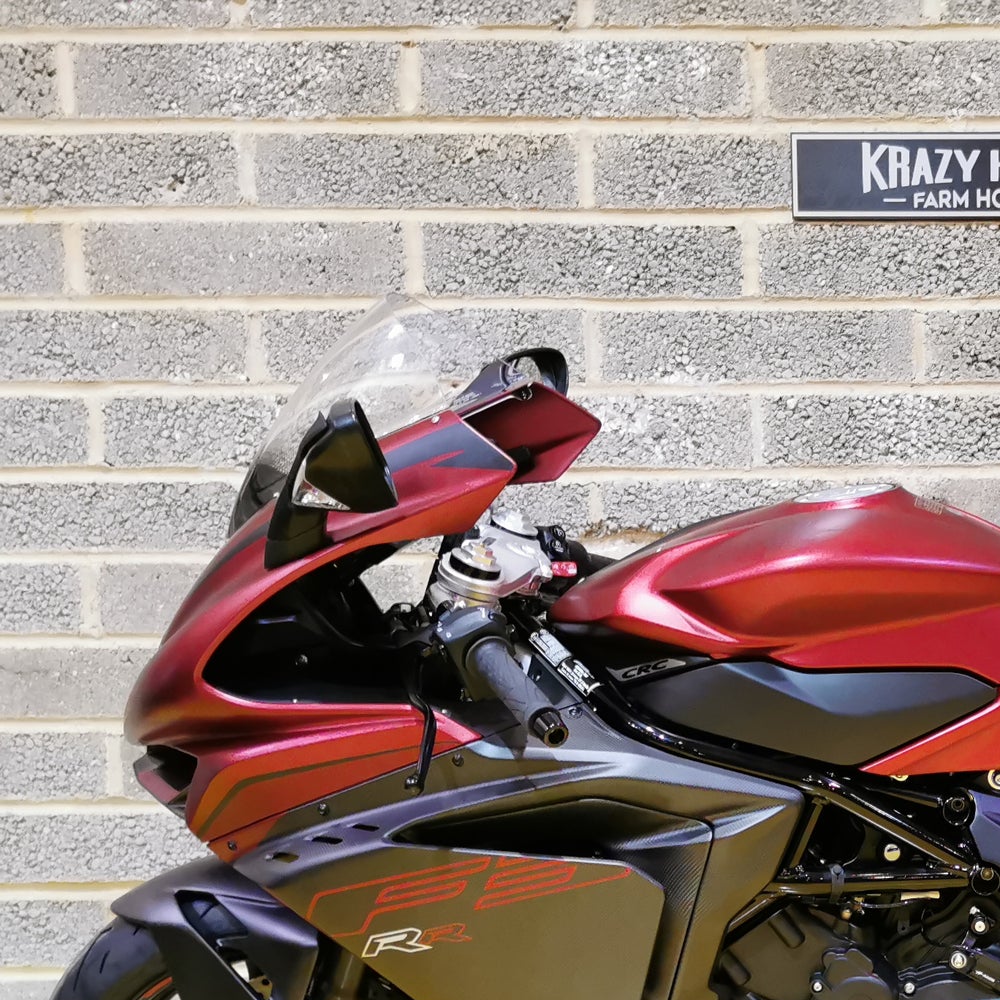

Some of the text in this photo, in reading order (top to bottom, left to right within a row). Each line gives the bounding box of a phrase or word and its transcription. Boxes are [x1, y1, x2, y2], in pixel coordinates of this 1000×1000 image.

[861, 141, 981, 193] KRAZY
[913, 189, 969, 208] FARM
[622, 659, 668, 679] CRC
